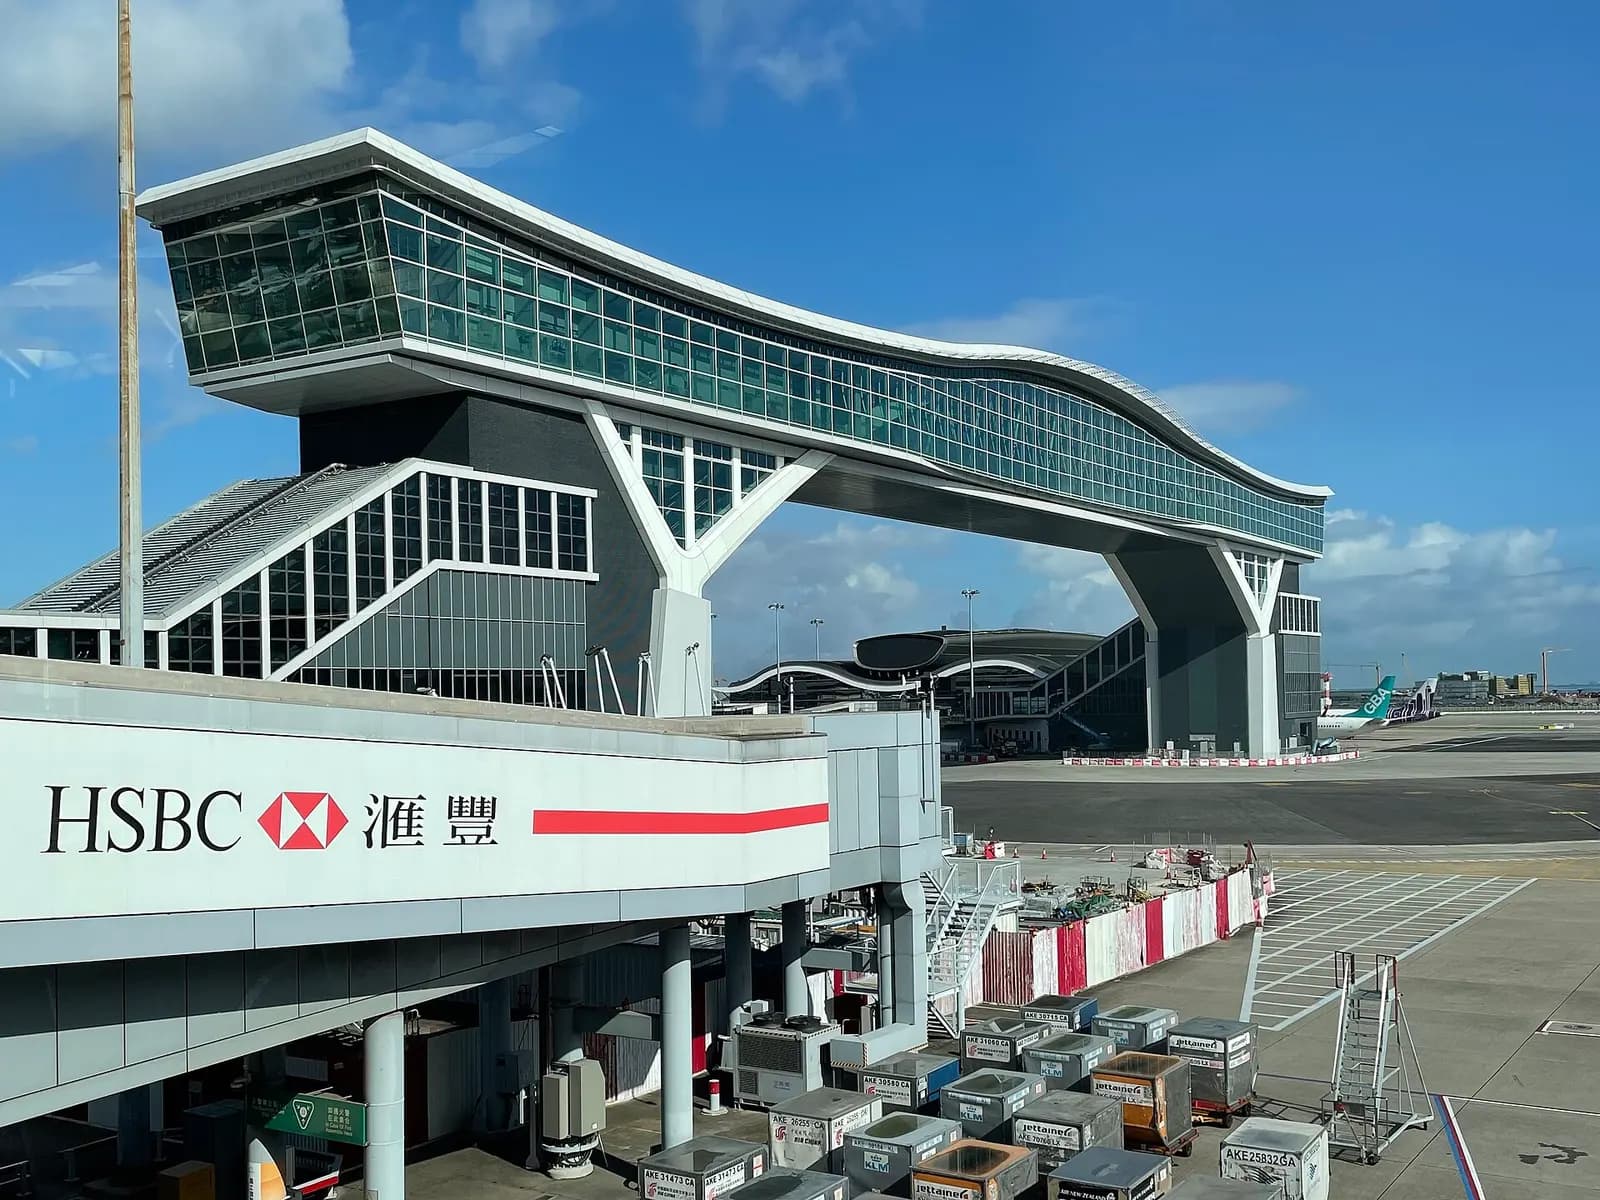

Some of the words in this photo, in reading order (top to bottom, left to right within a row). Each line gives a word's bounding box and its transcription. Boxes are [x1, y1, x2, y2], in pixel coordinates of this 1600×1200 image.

[1363, 687, 1391, 715] GBA
[40, 784, 243, 854] HSBC
[966, 1036, 979, 1044] AKE
[1041, 1068, 1062, 1077] KLM
[900, 1081, 910, 1089] CA
[960, 1111, 983, 1121] KLM
[772, 1115, 787, 1124] AKE
[813, 1121, 825, 1130] CA
[865, 1160, 889, 1173] KLM
[645, 1170, 659, 1180] AKE
[659, 1171, 684, 1184] 31473
[684, 1178, 695, 1187] CA
[705, 1177, 717, 1187] AKE
[1082, 1192, 1107, 1200] ZEALAND
